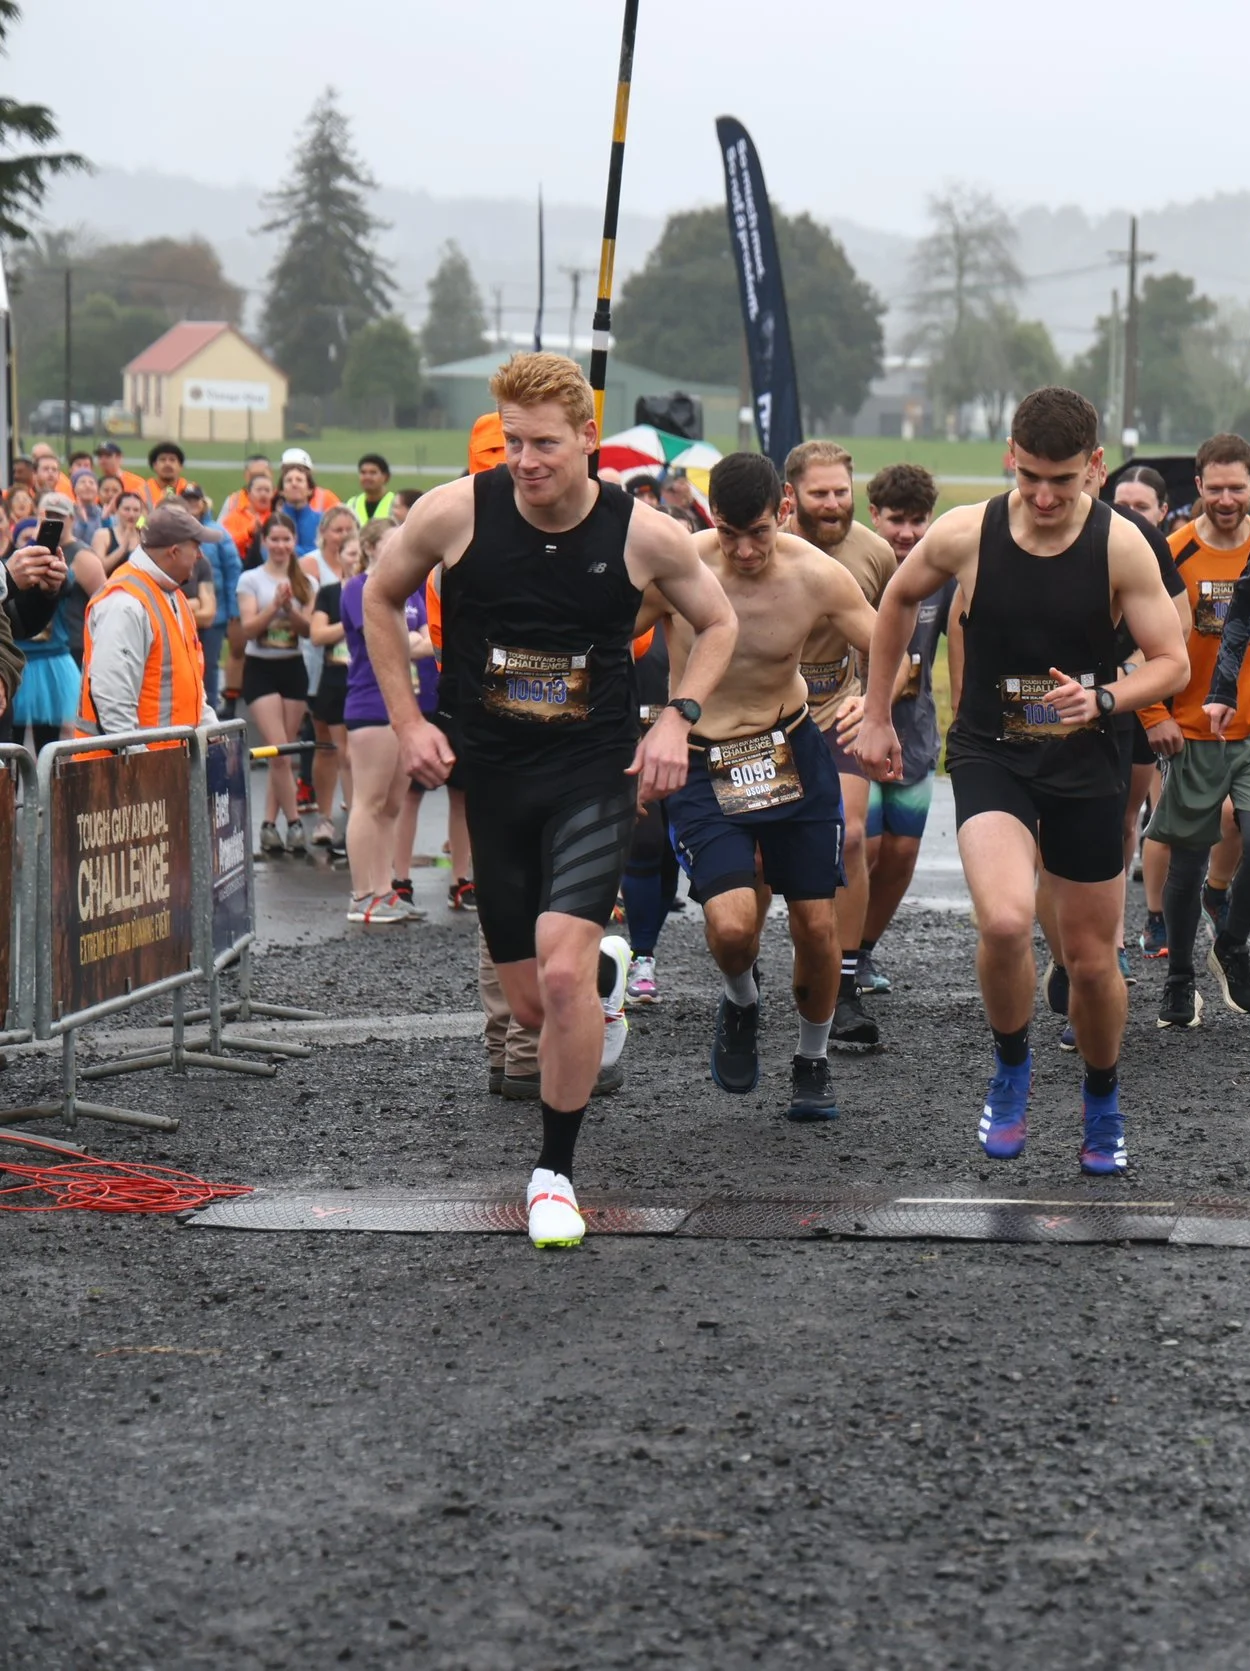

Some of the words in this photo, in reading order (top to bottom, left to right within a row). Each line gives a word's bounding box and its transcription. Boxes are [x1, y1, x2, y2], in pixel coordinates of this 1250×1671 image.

[736, 138, 748, 170] So
[508, 658, 570, 670] CHALLENGE
[506, 679, 566, 704] 10013
[722, 740, 772, 758] CHALLENGE
[731, 758, 776, 788] 9095
[746, 784, 771, 797] OSCAR
[77, 810, 110, 852] TOUGH
[112, 804, 132, 844] GUY
[132, 803, 150, 840] AND
[152, 799, 168, 836] GAL
[78, 841, 170, 922] CHALLENGE
